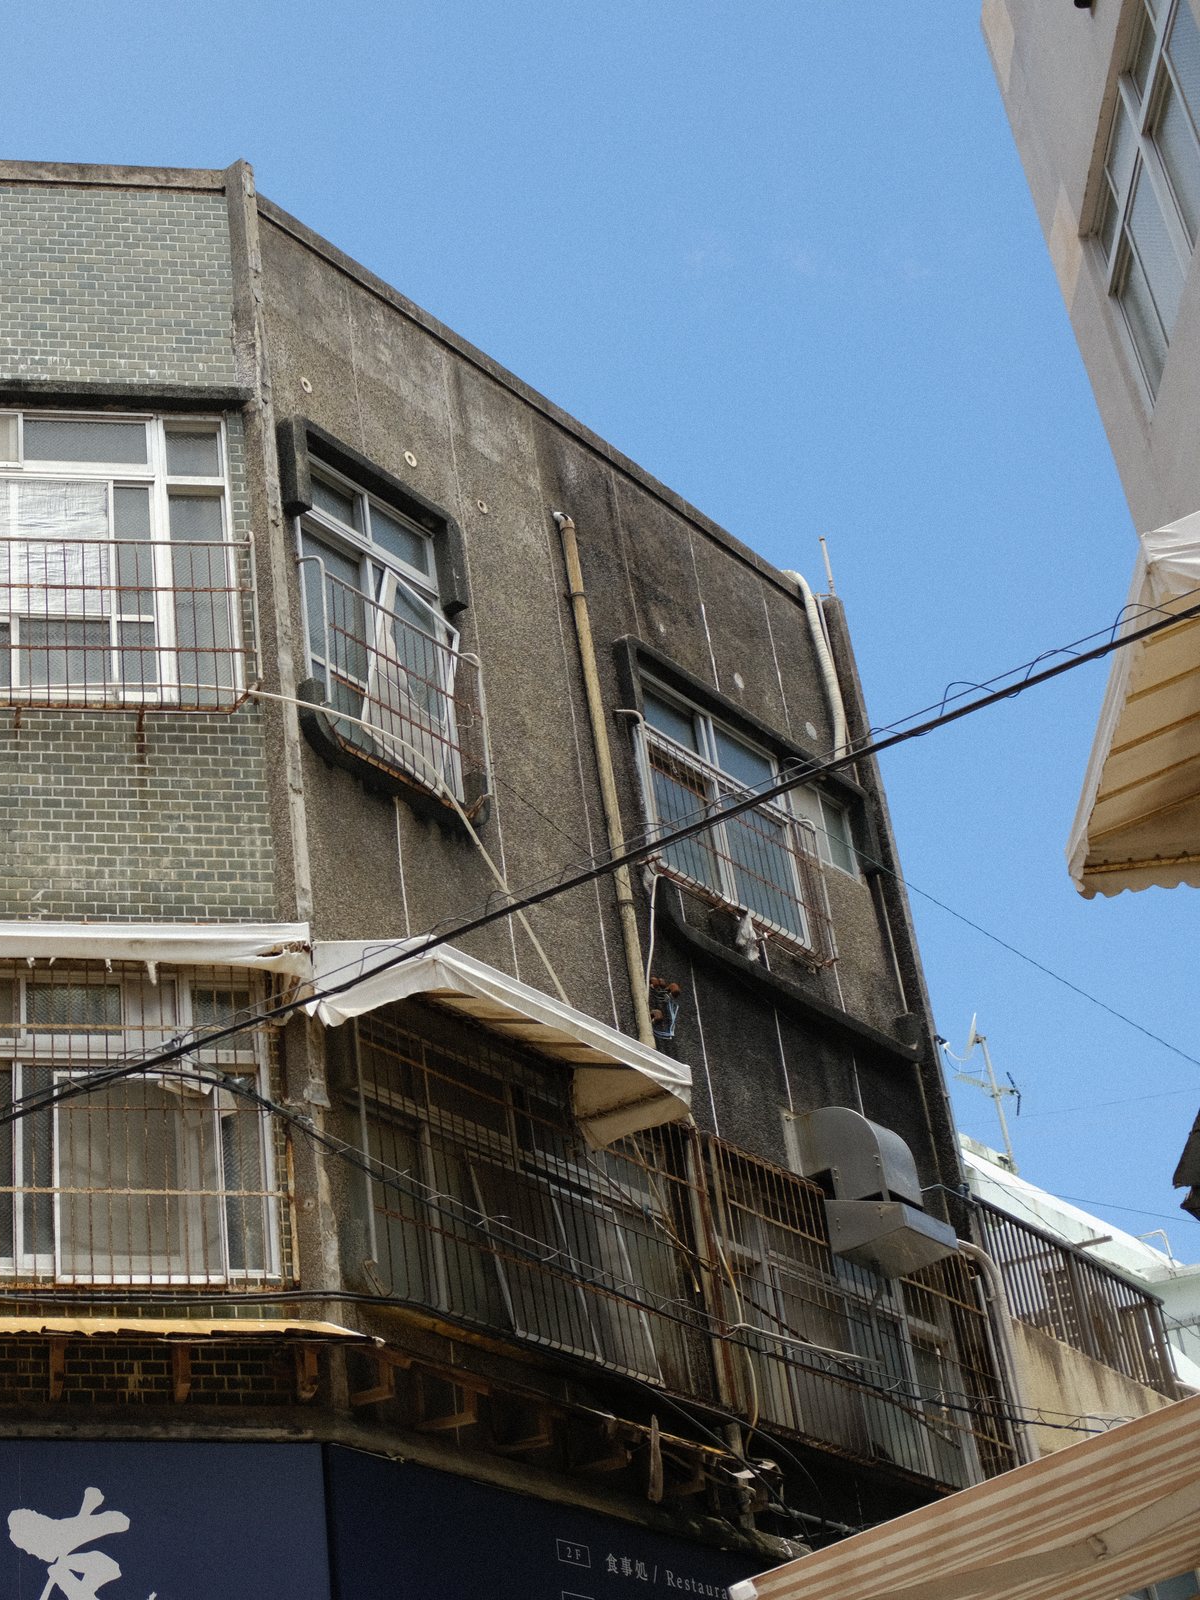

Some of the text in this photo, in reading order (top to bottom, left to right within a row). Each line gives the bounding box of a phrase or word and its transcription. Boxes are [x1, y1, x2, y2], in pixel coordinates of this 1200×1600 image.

[566, 1546, 582, 1560] 2F
[605, 1552, 649, 1582] 食事処
[665, 1569, 728, 1600] Restaura
